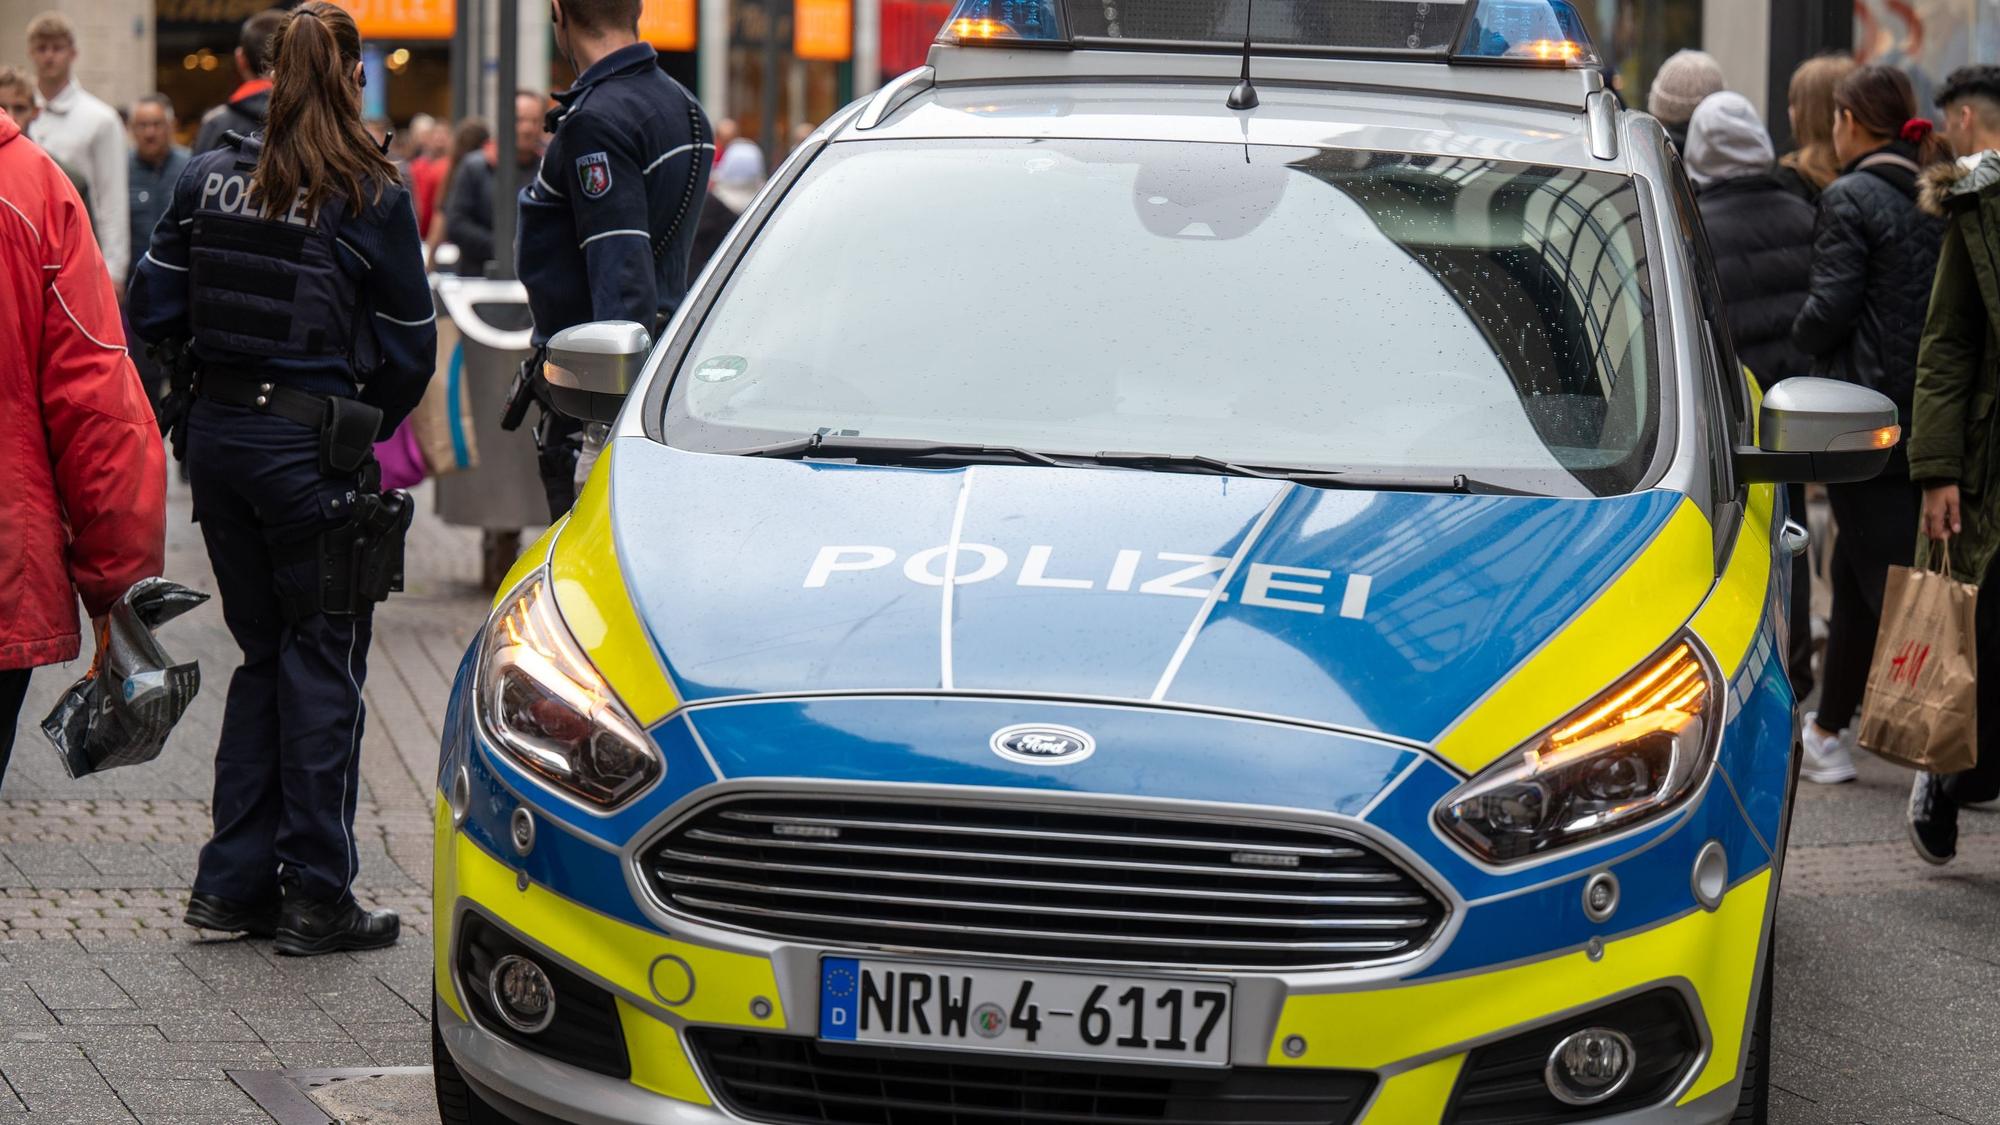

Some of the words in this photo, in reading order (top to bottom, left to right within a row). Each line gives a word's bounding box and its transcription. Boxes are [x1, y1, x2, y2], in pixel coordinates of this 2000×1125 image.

[802, 543, 1372, 620] POLIZEI
[1017, 734, 1068, 754] Ford
[832, 1007, 846, 1025] D
[859, 969, 972, 1038] NRW
[1010, 980, 1227, 1053] 4-6117
